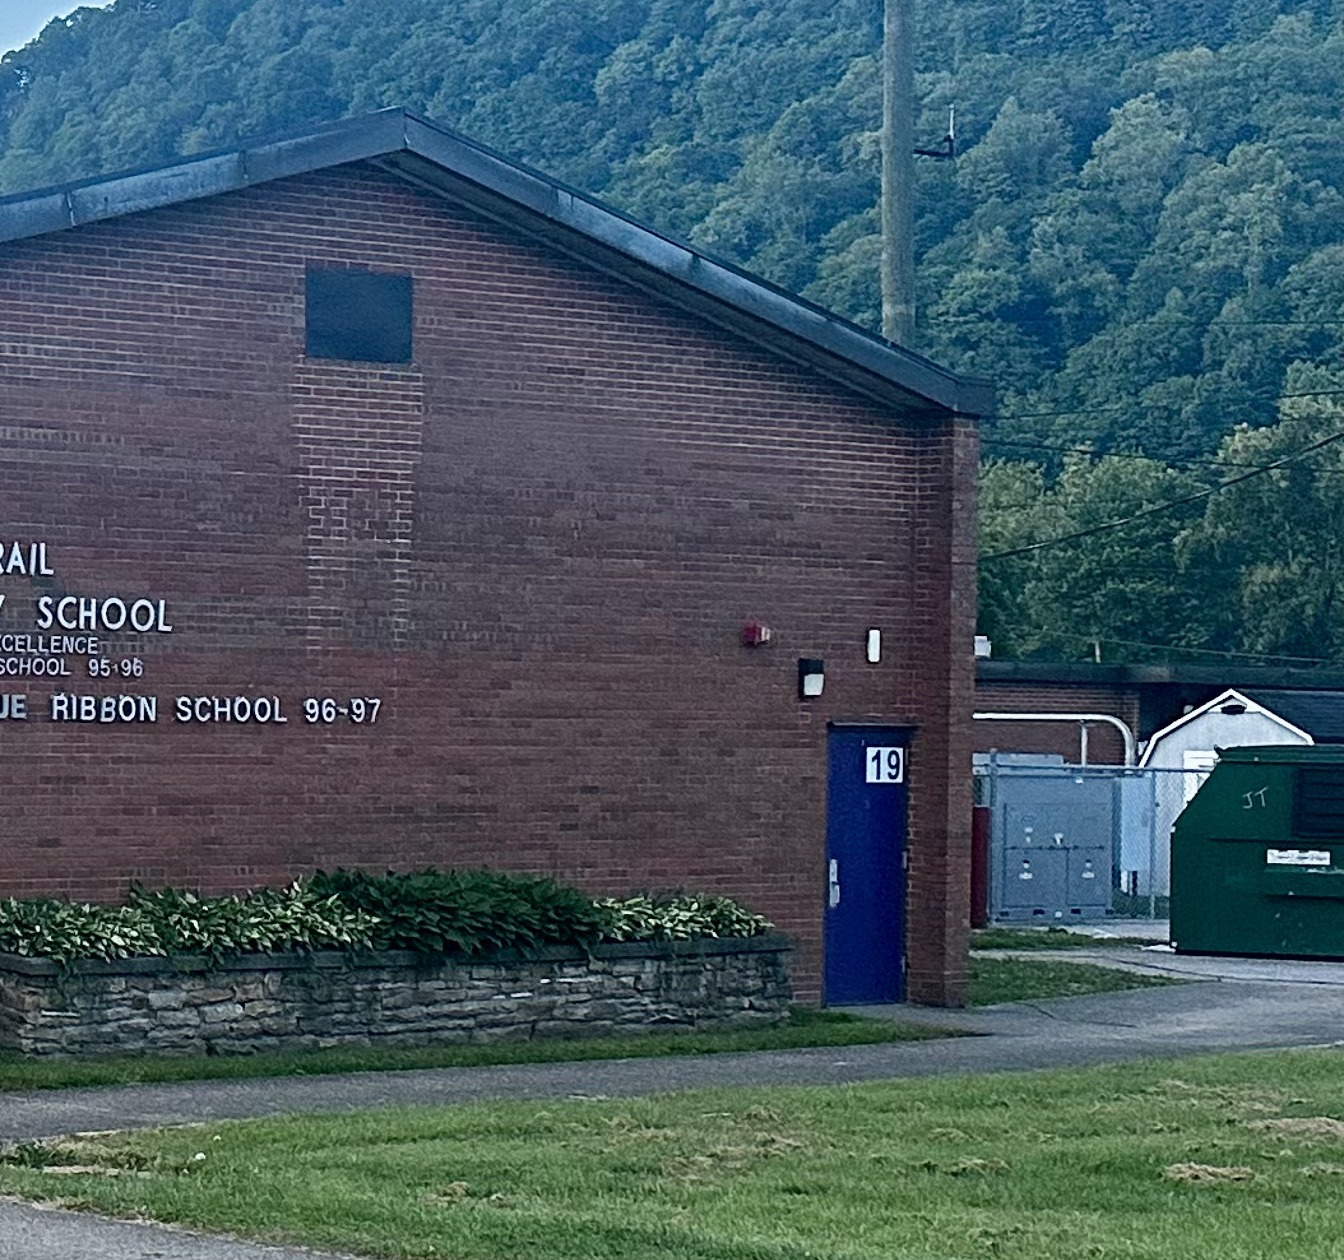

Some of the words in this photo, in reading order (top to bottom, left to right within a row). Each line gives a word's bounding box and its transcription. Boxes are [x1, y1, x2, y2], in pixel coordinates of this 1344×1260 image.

[37, 596, 173, 632] SCHOOL
[51, 694, 157, 722] RIBBON
[176, 696, 288, 722] SCHOOL
[304, 698, 381, 723] 96-97
[872, 749, 901, 780] 19
